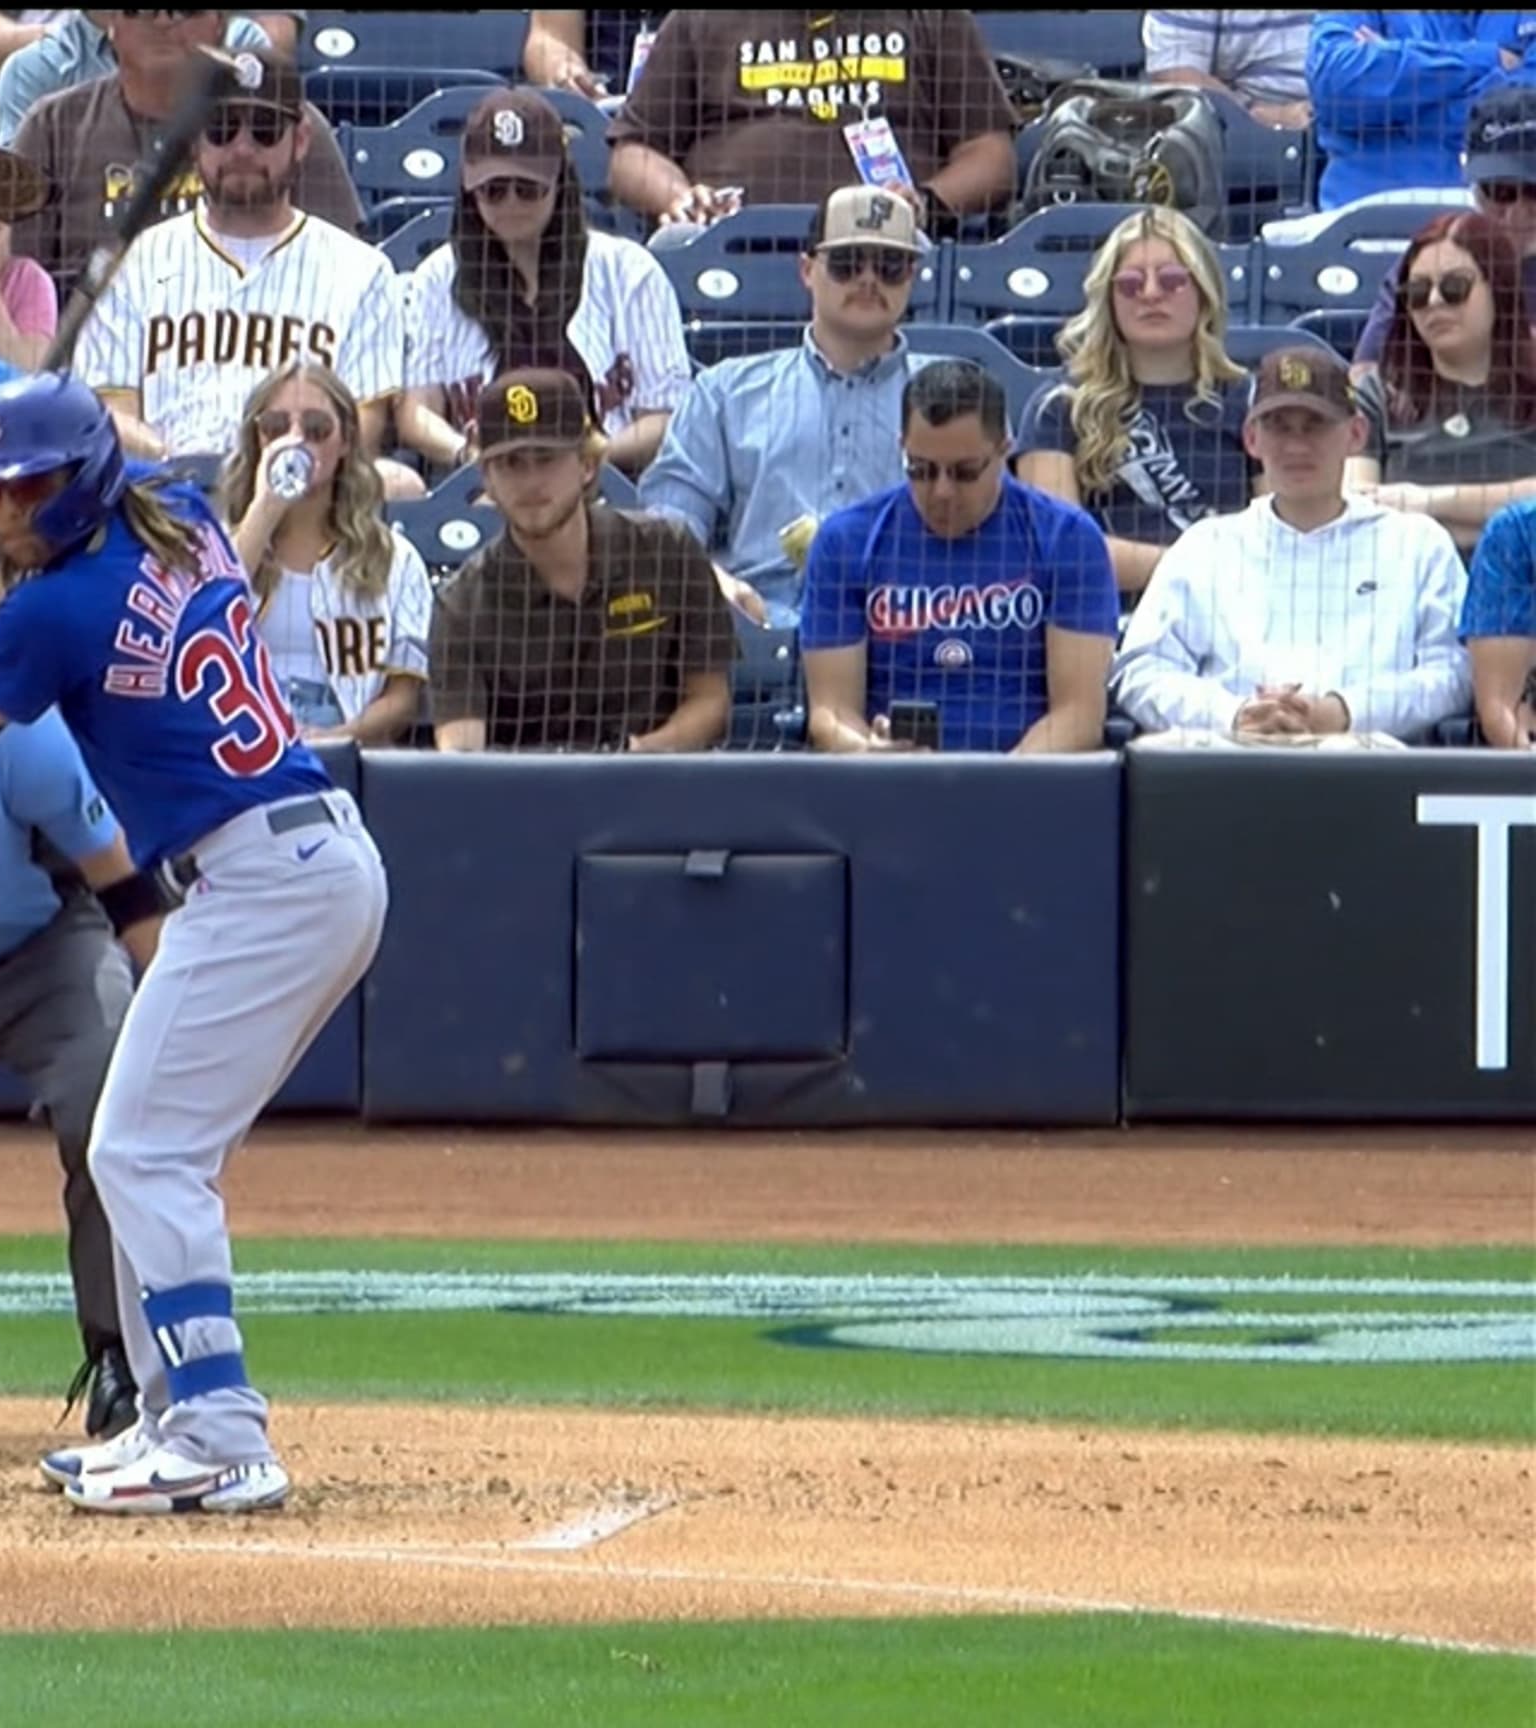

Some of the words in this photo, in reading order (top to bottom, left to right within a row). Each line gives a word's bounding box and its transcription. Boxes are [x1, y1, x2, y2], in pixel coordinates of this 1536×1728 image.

[740, 39, 797, 64] SAN
[813, 32, 905, 60] DIEGO
[148, 308, 336, 375] PADRES
[506, 385, 539, 423] SD
[866, 583, 1043, 633] CHICAGO
[175, 595, 300, 778] 32
